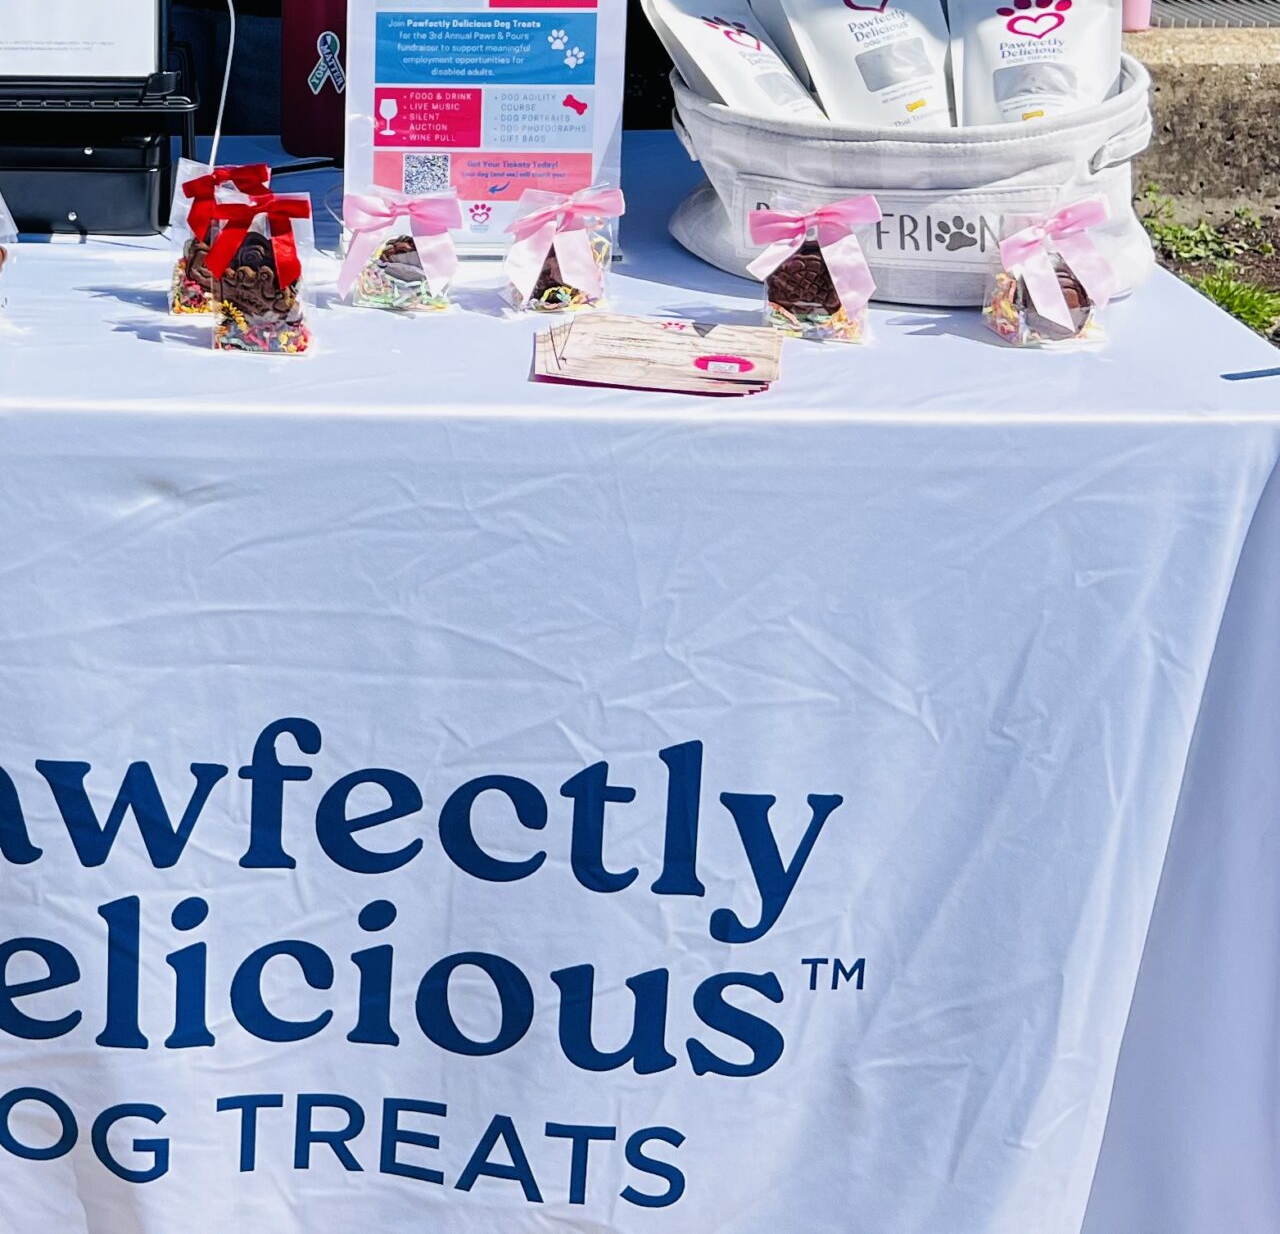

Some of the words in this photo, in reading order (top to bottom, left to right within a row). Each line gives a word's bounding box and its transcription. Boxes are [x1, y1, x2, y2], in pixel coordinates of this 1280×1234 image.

[388, 19, 406, 28] Join
[406, 19, 450, 30] Pawfectly
[452, 19, 492, 28] Delicious
[493, 19, 511, 30] Dog
[513, 19, 542, 28] Treats
[847, 8, 907, 33] Pawfectly
[399, 31, 411, 40] for
[413, 31, 427, 40] the
[428, 31, 443, 40] 3rd
[444, 31, 472, 40] Annual
[473, 31, 495, 40] Paws
[497, 31, 504, 40] &
[505, 31, 529, 40] Pours
[852, 21, 910, 43] Delicious
[397, 43, 439, 51] fundraiser
[440, 43, 450, 52] to
[451, 43, 484, 53] support
[485, 43, 531, 53] meaningful
[999, 37, 1065, 50] Pawfectly
[1001, 46, 1063, 59] Delicious
[402, 56, 453, 65] employment
[455, 55, 511, 65] opportunities
[512, 55, 525, 64] for
[320, 44, 344, 86] MATTER
[310, 61, 328, 85] YOU
[431, 68, 466, 76] disabled
[467, 68, 495, 76] adults.
[409, 92, 433, 100] FOOD
[445, 92, 472, 100] DRINK
[409, 103, 428, 111] LIVE
[431, 103, 460, 111] MUSIC
[500, 103, 536, 111] COURSE
[409, 113, 440, 121] SILENT
[522, 114, 571, 122] PORTRAITS
[409, 123, 448, 131] AUCTION
[521, 124, 587, 133] PHOTOGRAPHS
[409, 133, 432, 141] WINE
[434, 133, 456, 141] PULL
[500, 135, 519, 143] GIFT
[532, 160, 559, 169] Today!
[213, 1093, 687, 1210] TREATS
